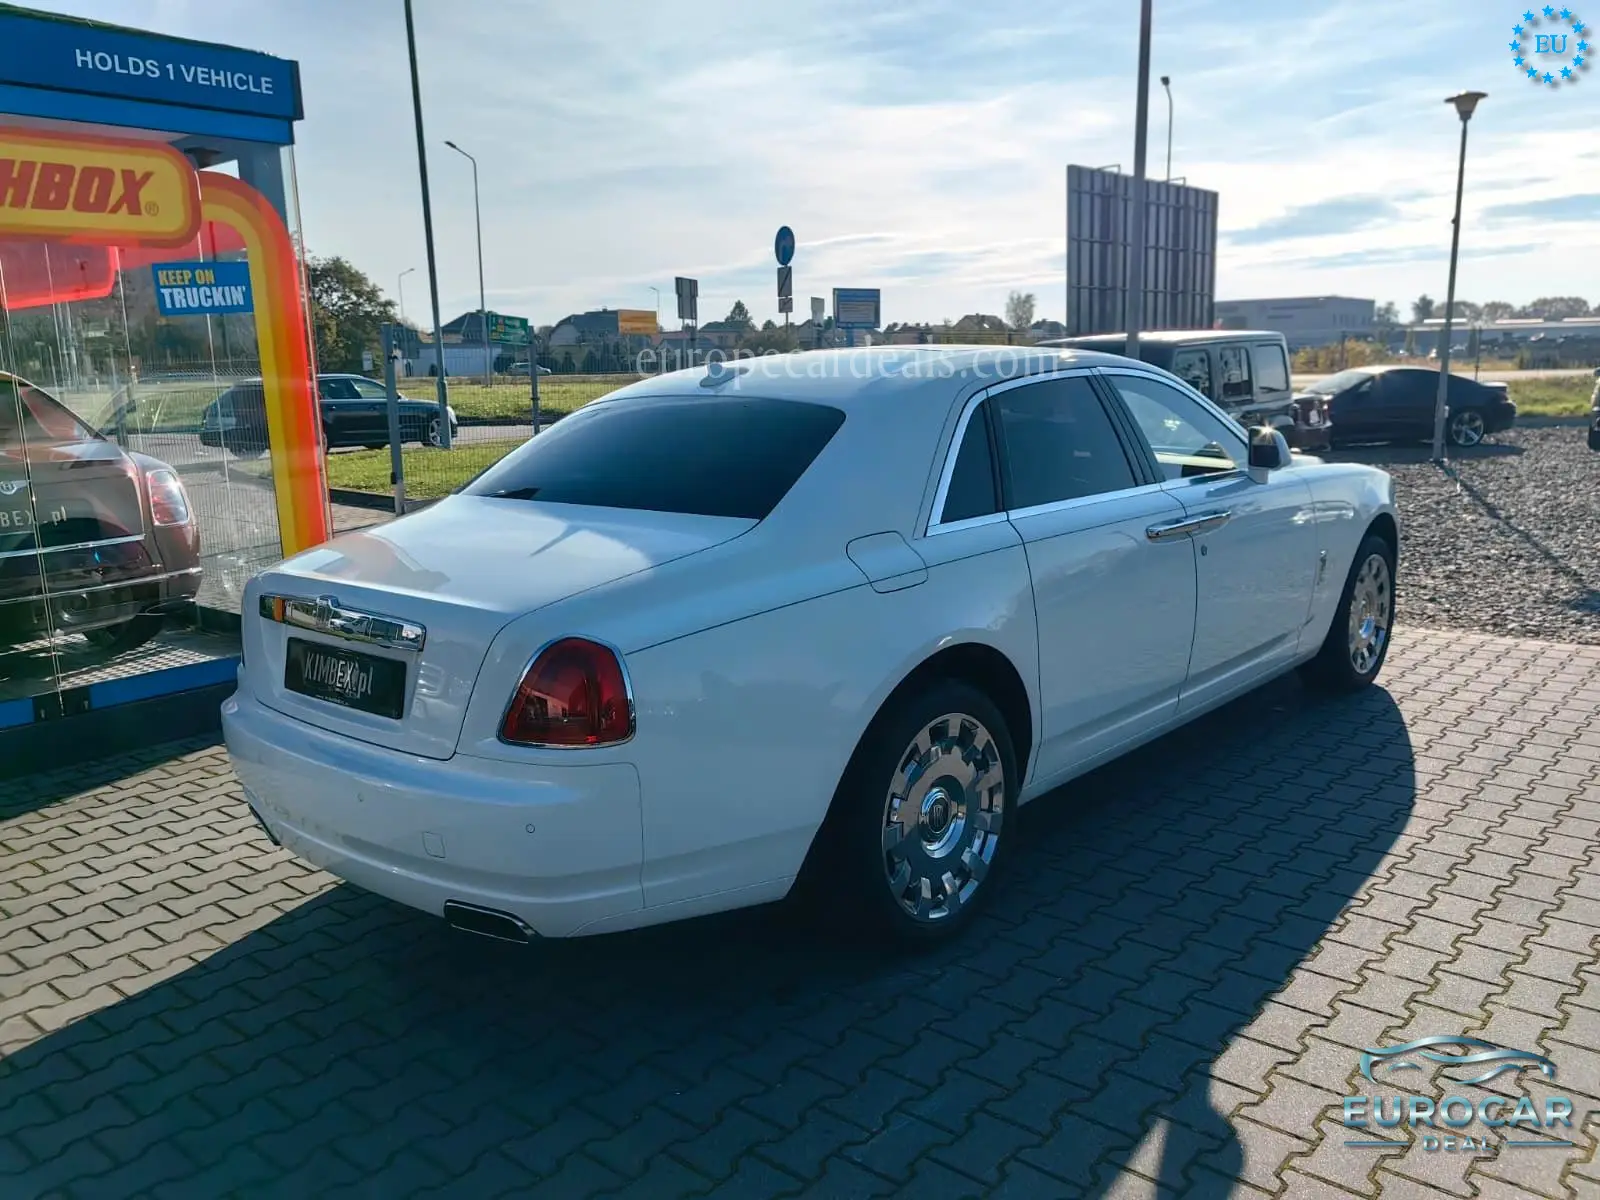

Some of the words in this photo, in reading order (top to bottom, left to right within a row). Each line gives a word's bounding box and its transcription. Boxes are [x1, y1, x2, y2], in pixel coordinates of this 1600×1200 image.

[75, 48, 161, 78] HOLDS
[166, 63, 175, 81] 1
[179, 64, 274, 95] VEHICLE
[157, 269, 192, 286] KEEP
[195, 268, 216, 285] ON
[160, 285, 246, 309] TRUCKIN'
[304, 651, 374, 699] KIMBEX.pl
